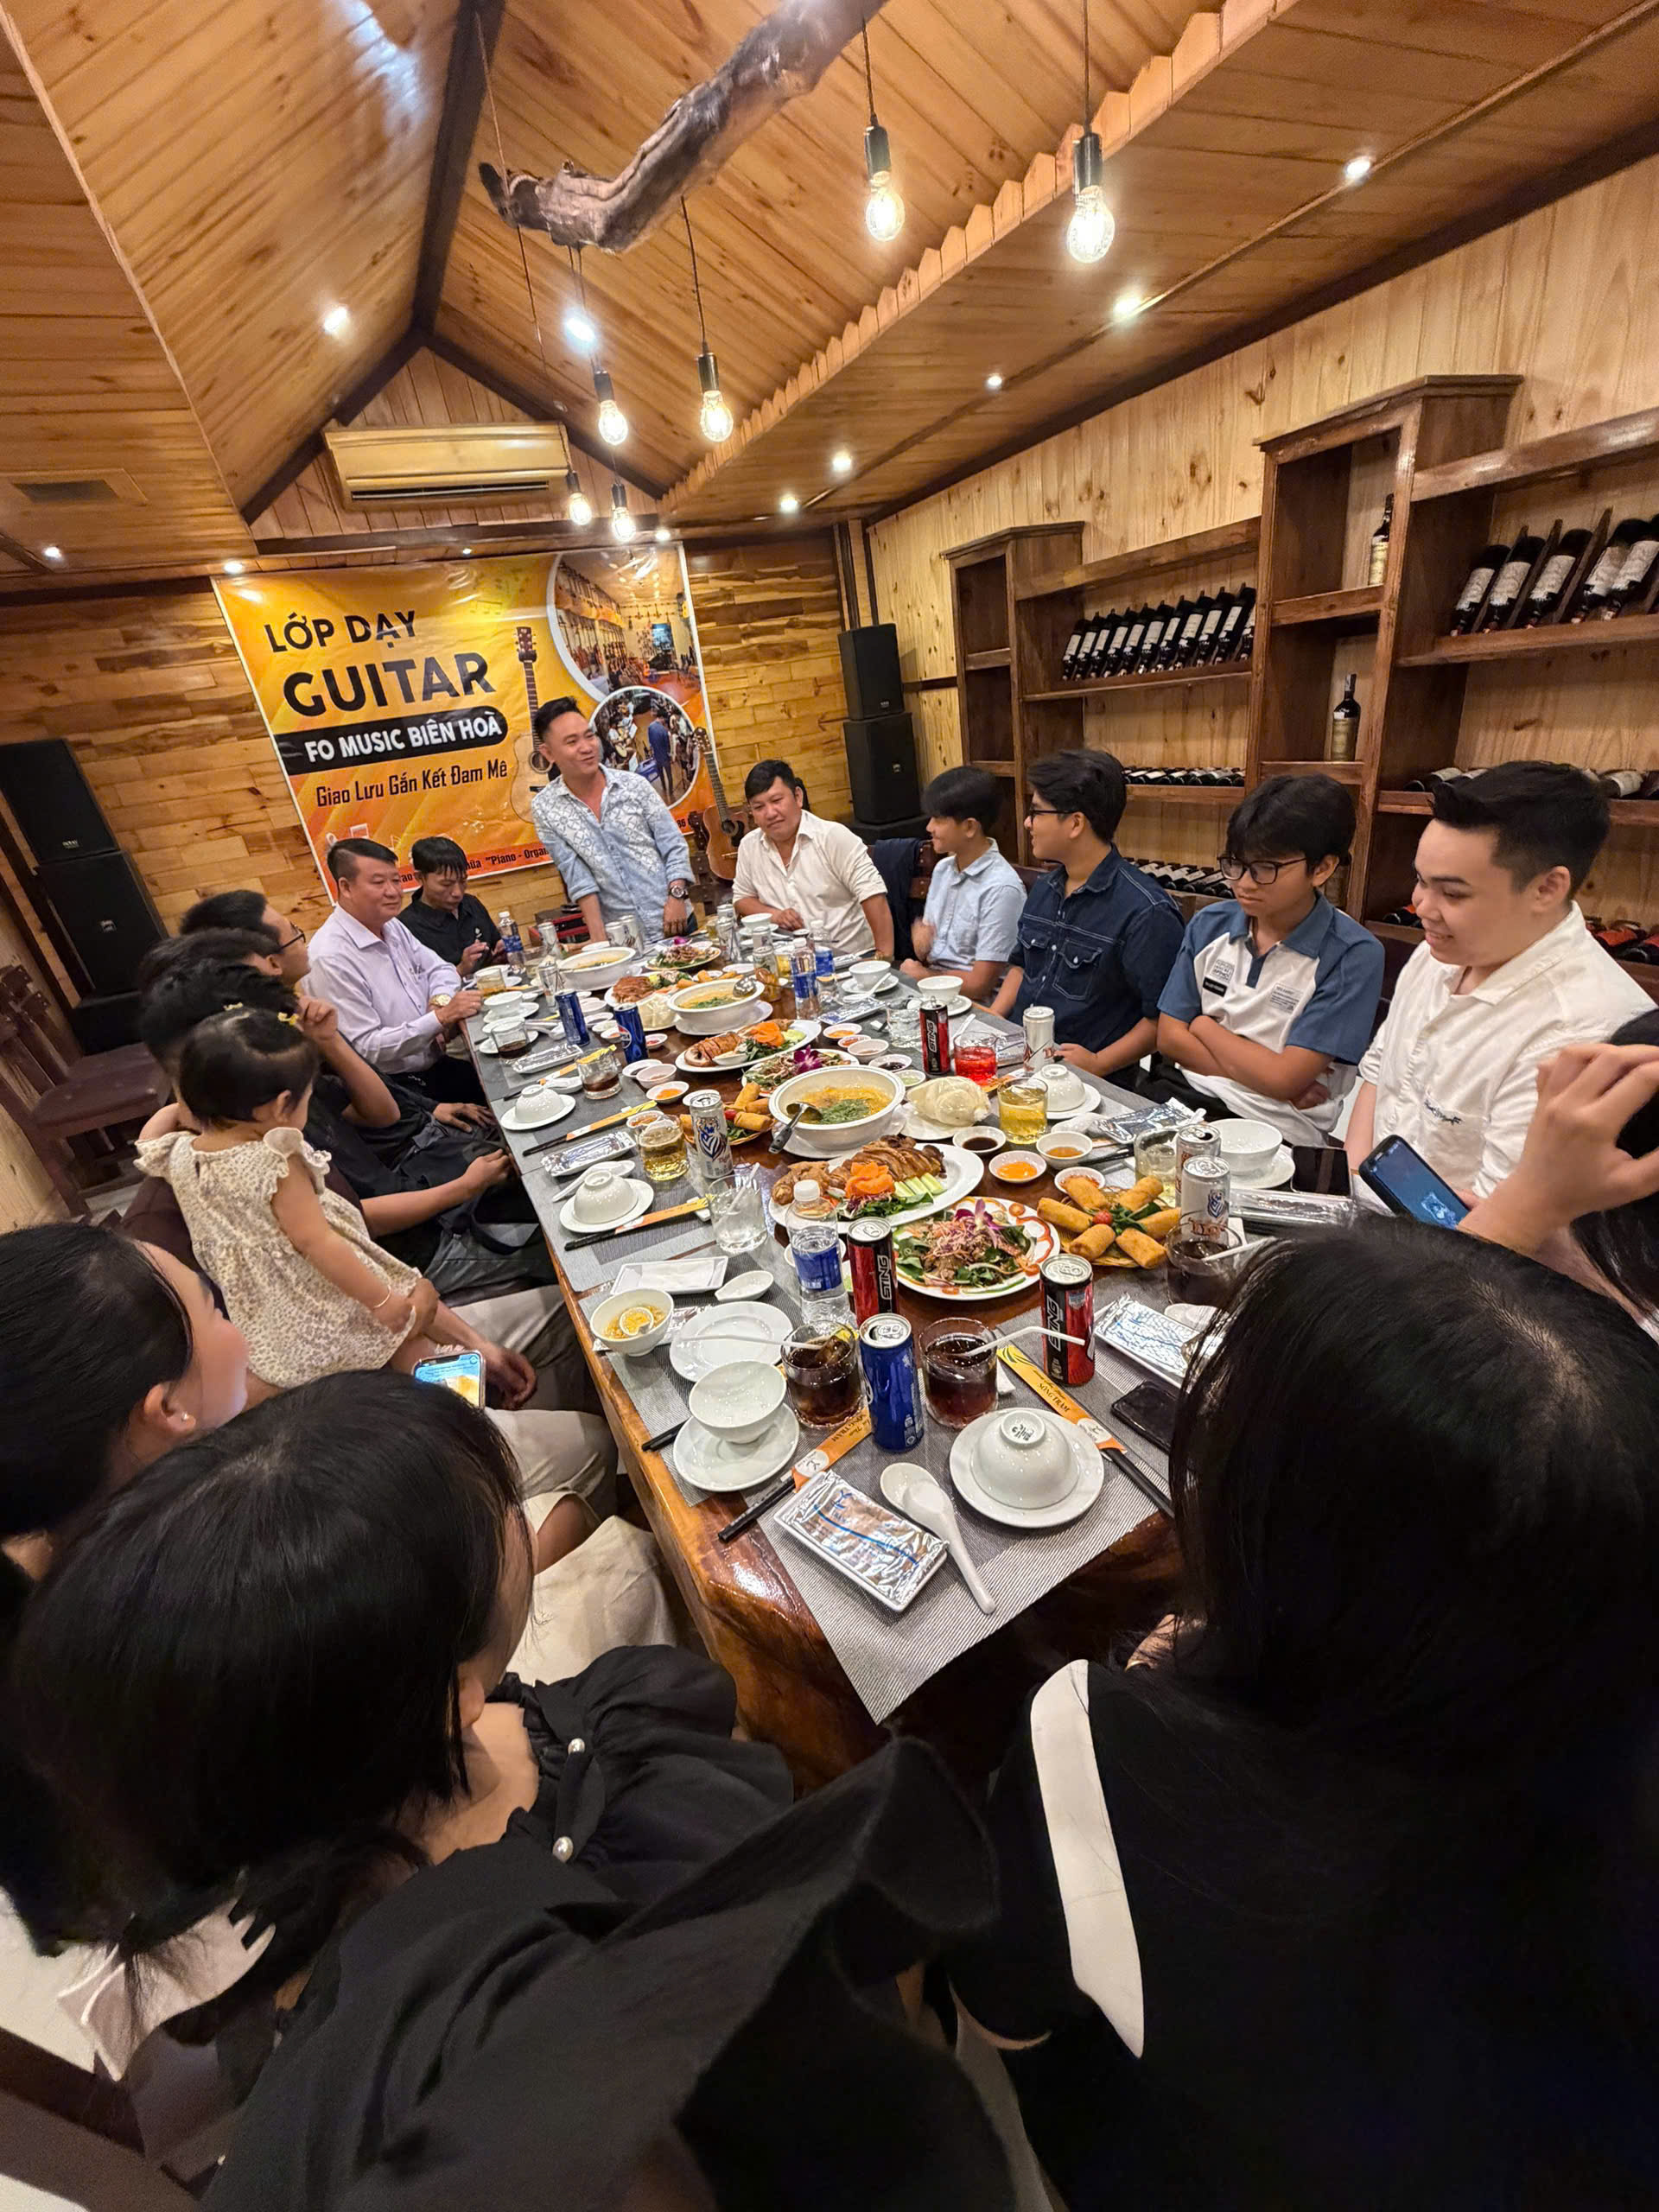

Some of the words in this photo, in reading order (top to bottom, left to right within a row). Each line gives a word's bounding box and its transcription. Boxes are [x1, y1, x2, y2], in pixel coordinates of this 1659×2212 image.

[264, 612, 334, 652] LỚP
[344, 610, 416, 648] DẠY
[283, 652, 496, 716] GUITAR
[304, 740, 334, 762] FO
[338, 728, 405, 758] MUSIC
[407, 720, 456, 747] BIÊN
[459, 710, 503, 740] HOÀ
[316, 786, 350, 807] Giao
[355, 780, 384, 801] Lưu
[389, 772, 417, 795] Gắn
[422, 766, 447, 790] Kết
[451, 765, 483, 785] Đam
[487, 759, 507, 779] Mê
[926, 1020, 938, 1052] STING
[877, 1255, 892, 1300] STING
